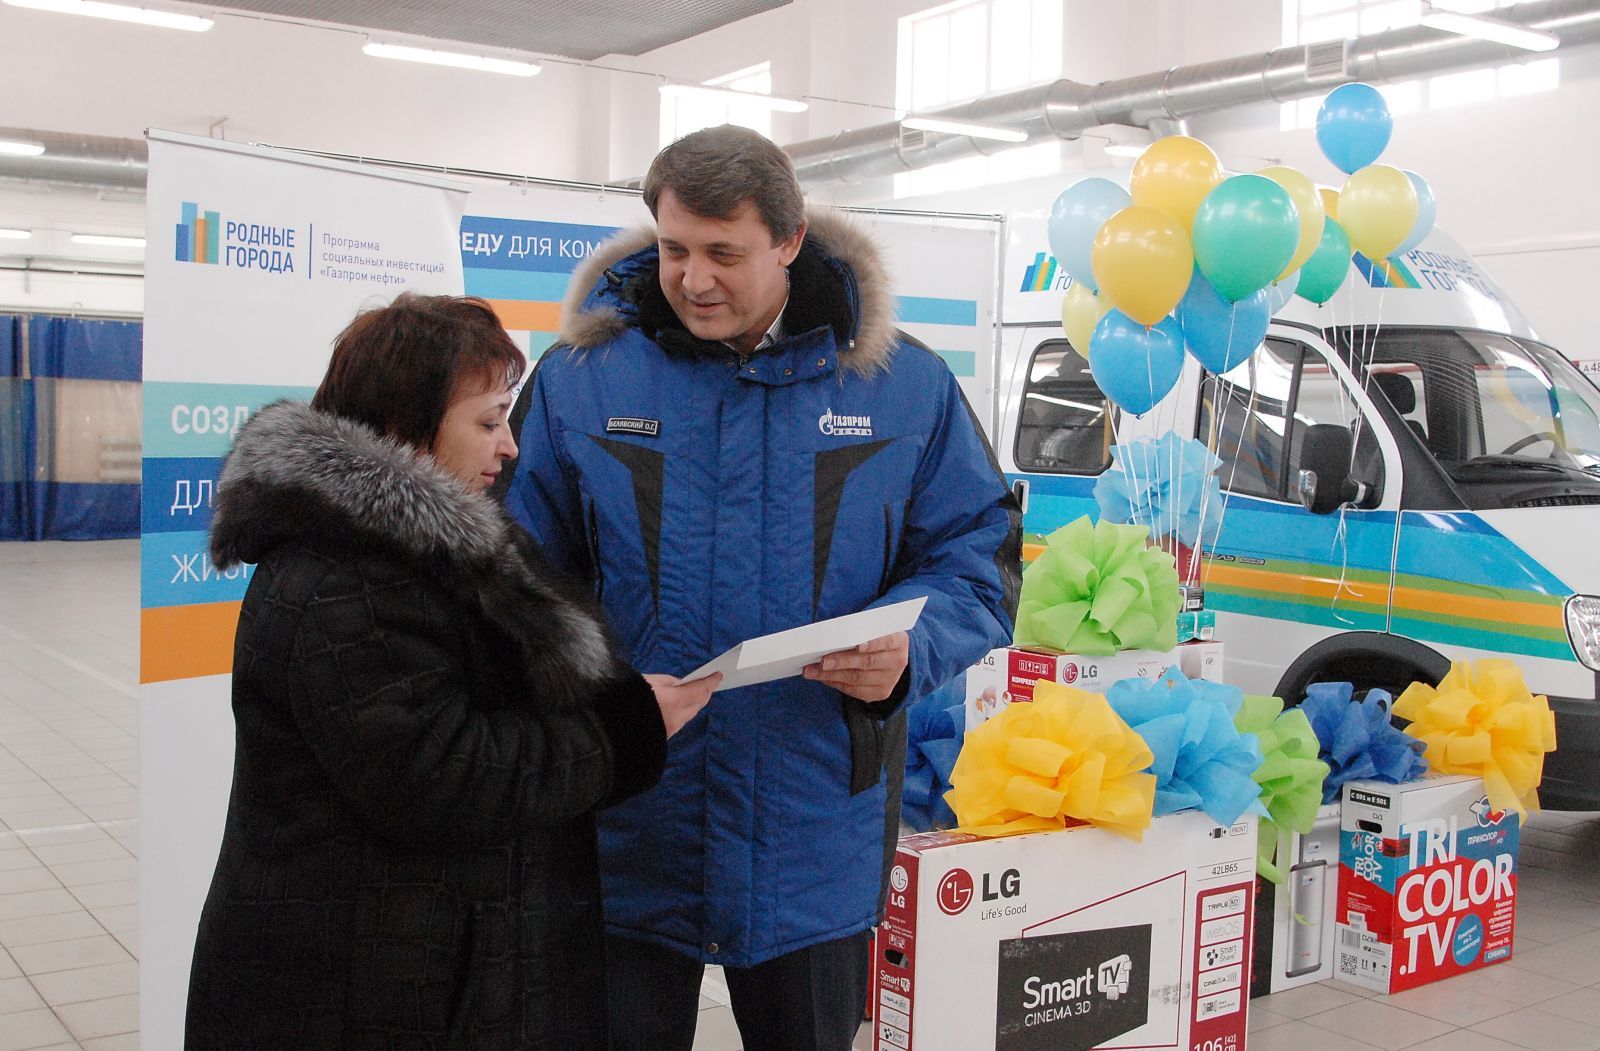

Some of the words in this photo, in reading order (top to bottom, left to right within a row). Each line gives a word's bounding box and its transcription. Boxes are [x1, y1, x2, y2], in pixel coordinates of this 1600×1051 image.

[226, 221, 295, 248] РОДНЫЕ
[323, 233, 380, 251] Программа
[508, 235, 552, 258] ДЛЯ
[226, 245, 294, 274] ГОРОДА
[322, 251, 383, 268] социальных
[386, 259, 445, 274] инвестиций
[320, 266, 368, 282] «Газпром
[370, 271, 406, 285] нефти»
[1420, 269, 1500, 301] ГОРДА
[833, 415, 871, 427] ГАЗПРОМ
[171, 479, 221, 516] ДЛ
[983, 656, 995, 666] LG
[1081, 664, 1098, 679] LG
[1402, 815, 1458, 871] TRI
[1211, 863, 1238, 875] 42LB65
[1353, 857, 1364, 878] TRI
[982, 868, 1021, 902] LG
[1397, 853, 1514, 923] COLOR
[890, 892, 906, 909] LG
[981, 907, 1003, 920] Life's
[1004, 903, 1027, 916] Good
[1207, 901, 1228, 911] TRIPLE
[1399, 916, 1457, 975] .TV
[880, 969, 900, 987] Smart
[1023, 967, 1094, 1009] Smart
[1102, 962, 1121, 985] TV
[1024, 1004, 1072, 1027] CINEMA
[1074, 1000, 1091, 1016] 3D
